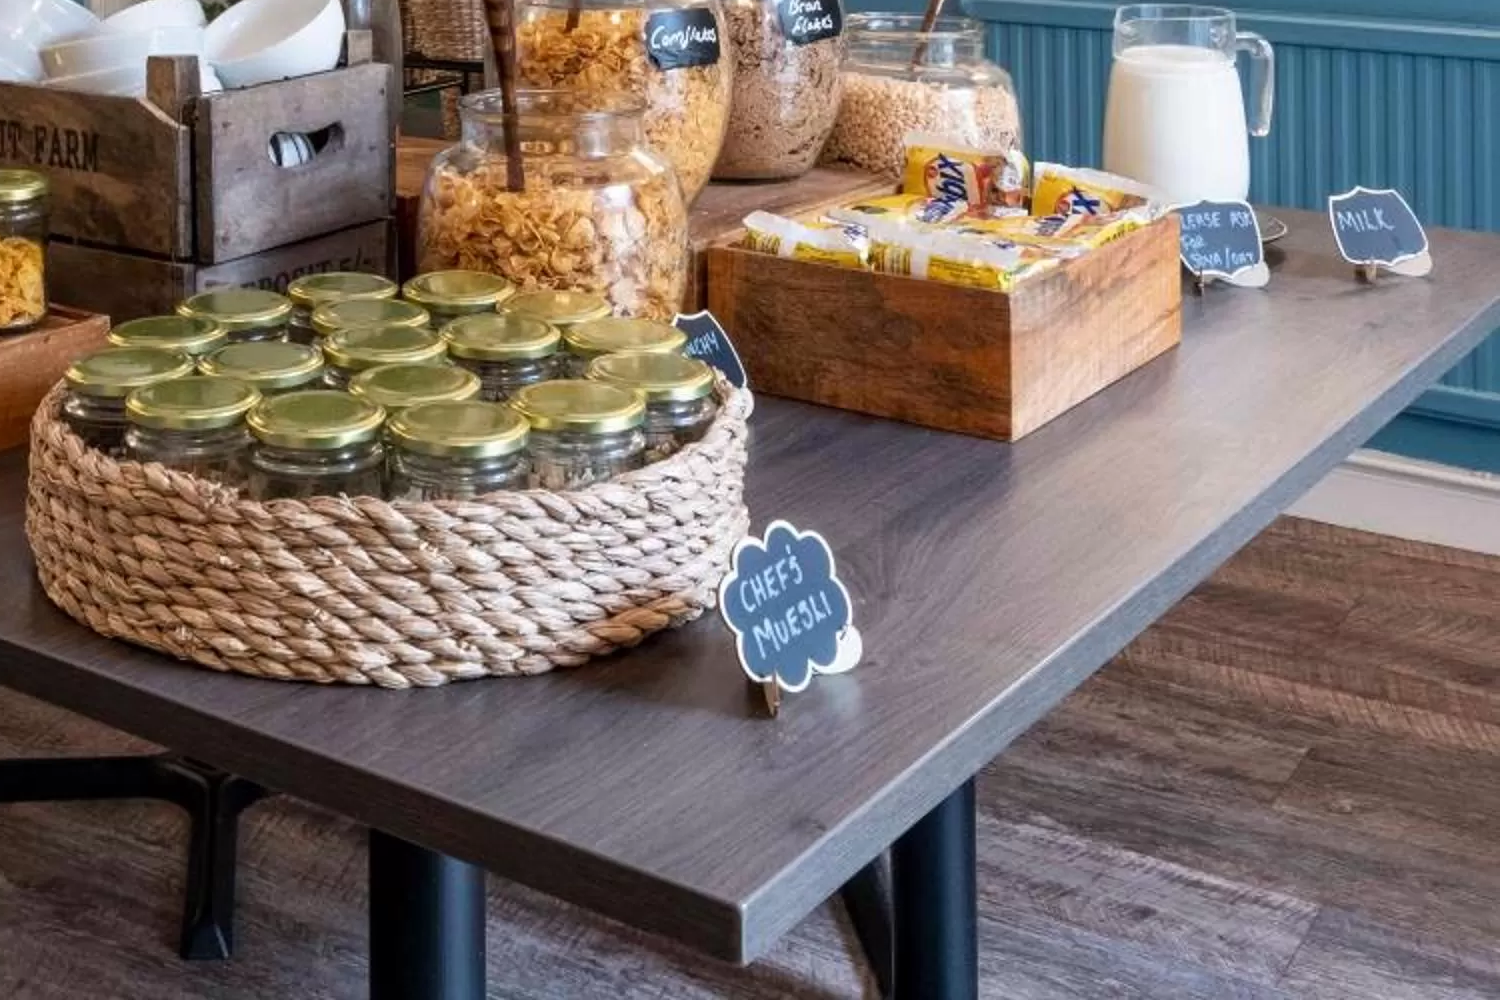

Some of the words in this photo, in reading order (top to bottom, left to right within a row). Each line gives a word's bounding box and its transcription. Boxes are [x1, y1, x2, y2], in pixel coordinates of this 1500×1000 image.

[33, 125, 100, 172] FARM
[1181, 211, 1221, 230] LEASE
[1336, 206, 1396, 232] MILK
[751, 590, 833, 661] MUESLI
